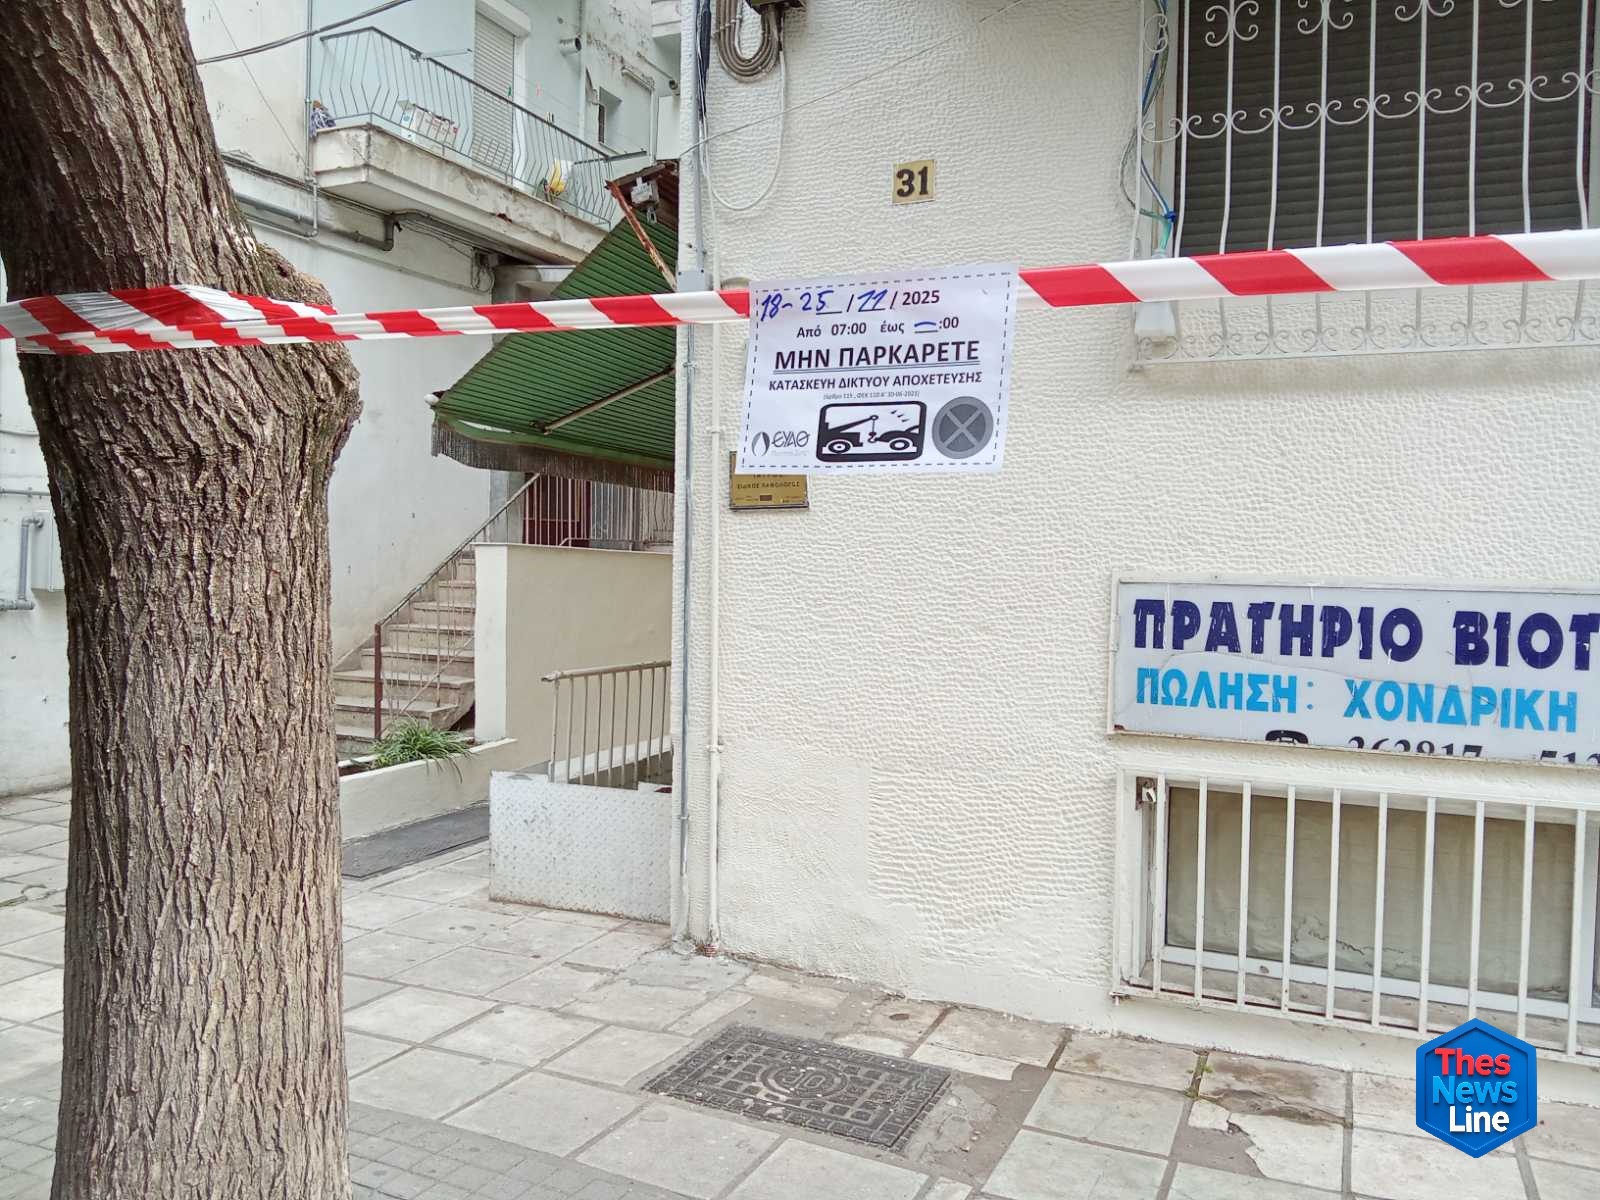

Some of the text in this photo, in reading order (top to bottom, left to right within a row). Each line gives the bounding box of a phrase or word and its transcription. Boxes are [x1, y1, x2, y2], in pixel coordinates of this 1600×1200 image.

[896, 166, 929, 197] 31
[796, 326, 822, 339] Από
[831, 322, 867, 337] 07:00
[880, 318, 905, 335] έως
[774, 340, 981, 370] ΜΗΝ ΠΑΡΚΑΡΕΤΕ
[768, 371, 984, 392] ΚΑΤΑΣΚΕΥΗ ΔΙΚΤΥΟΥ ΑΠΟΧΕΤΕΥΣΗΣ
[1133, 598, 1600, 671] ΠΡΑΤΗΡΙΟ ΒΙΟΤ
[1343, 678, 1578, 733] ΧΟΝΔΡΙΚΗ
